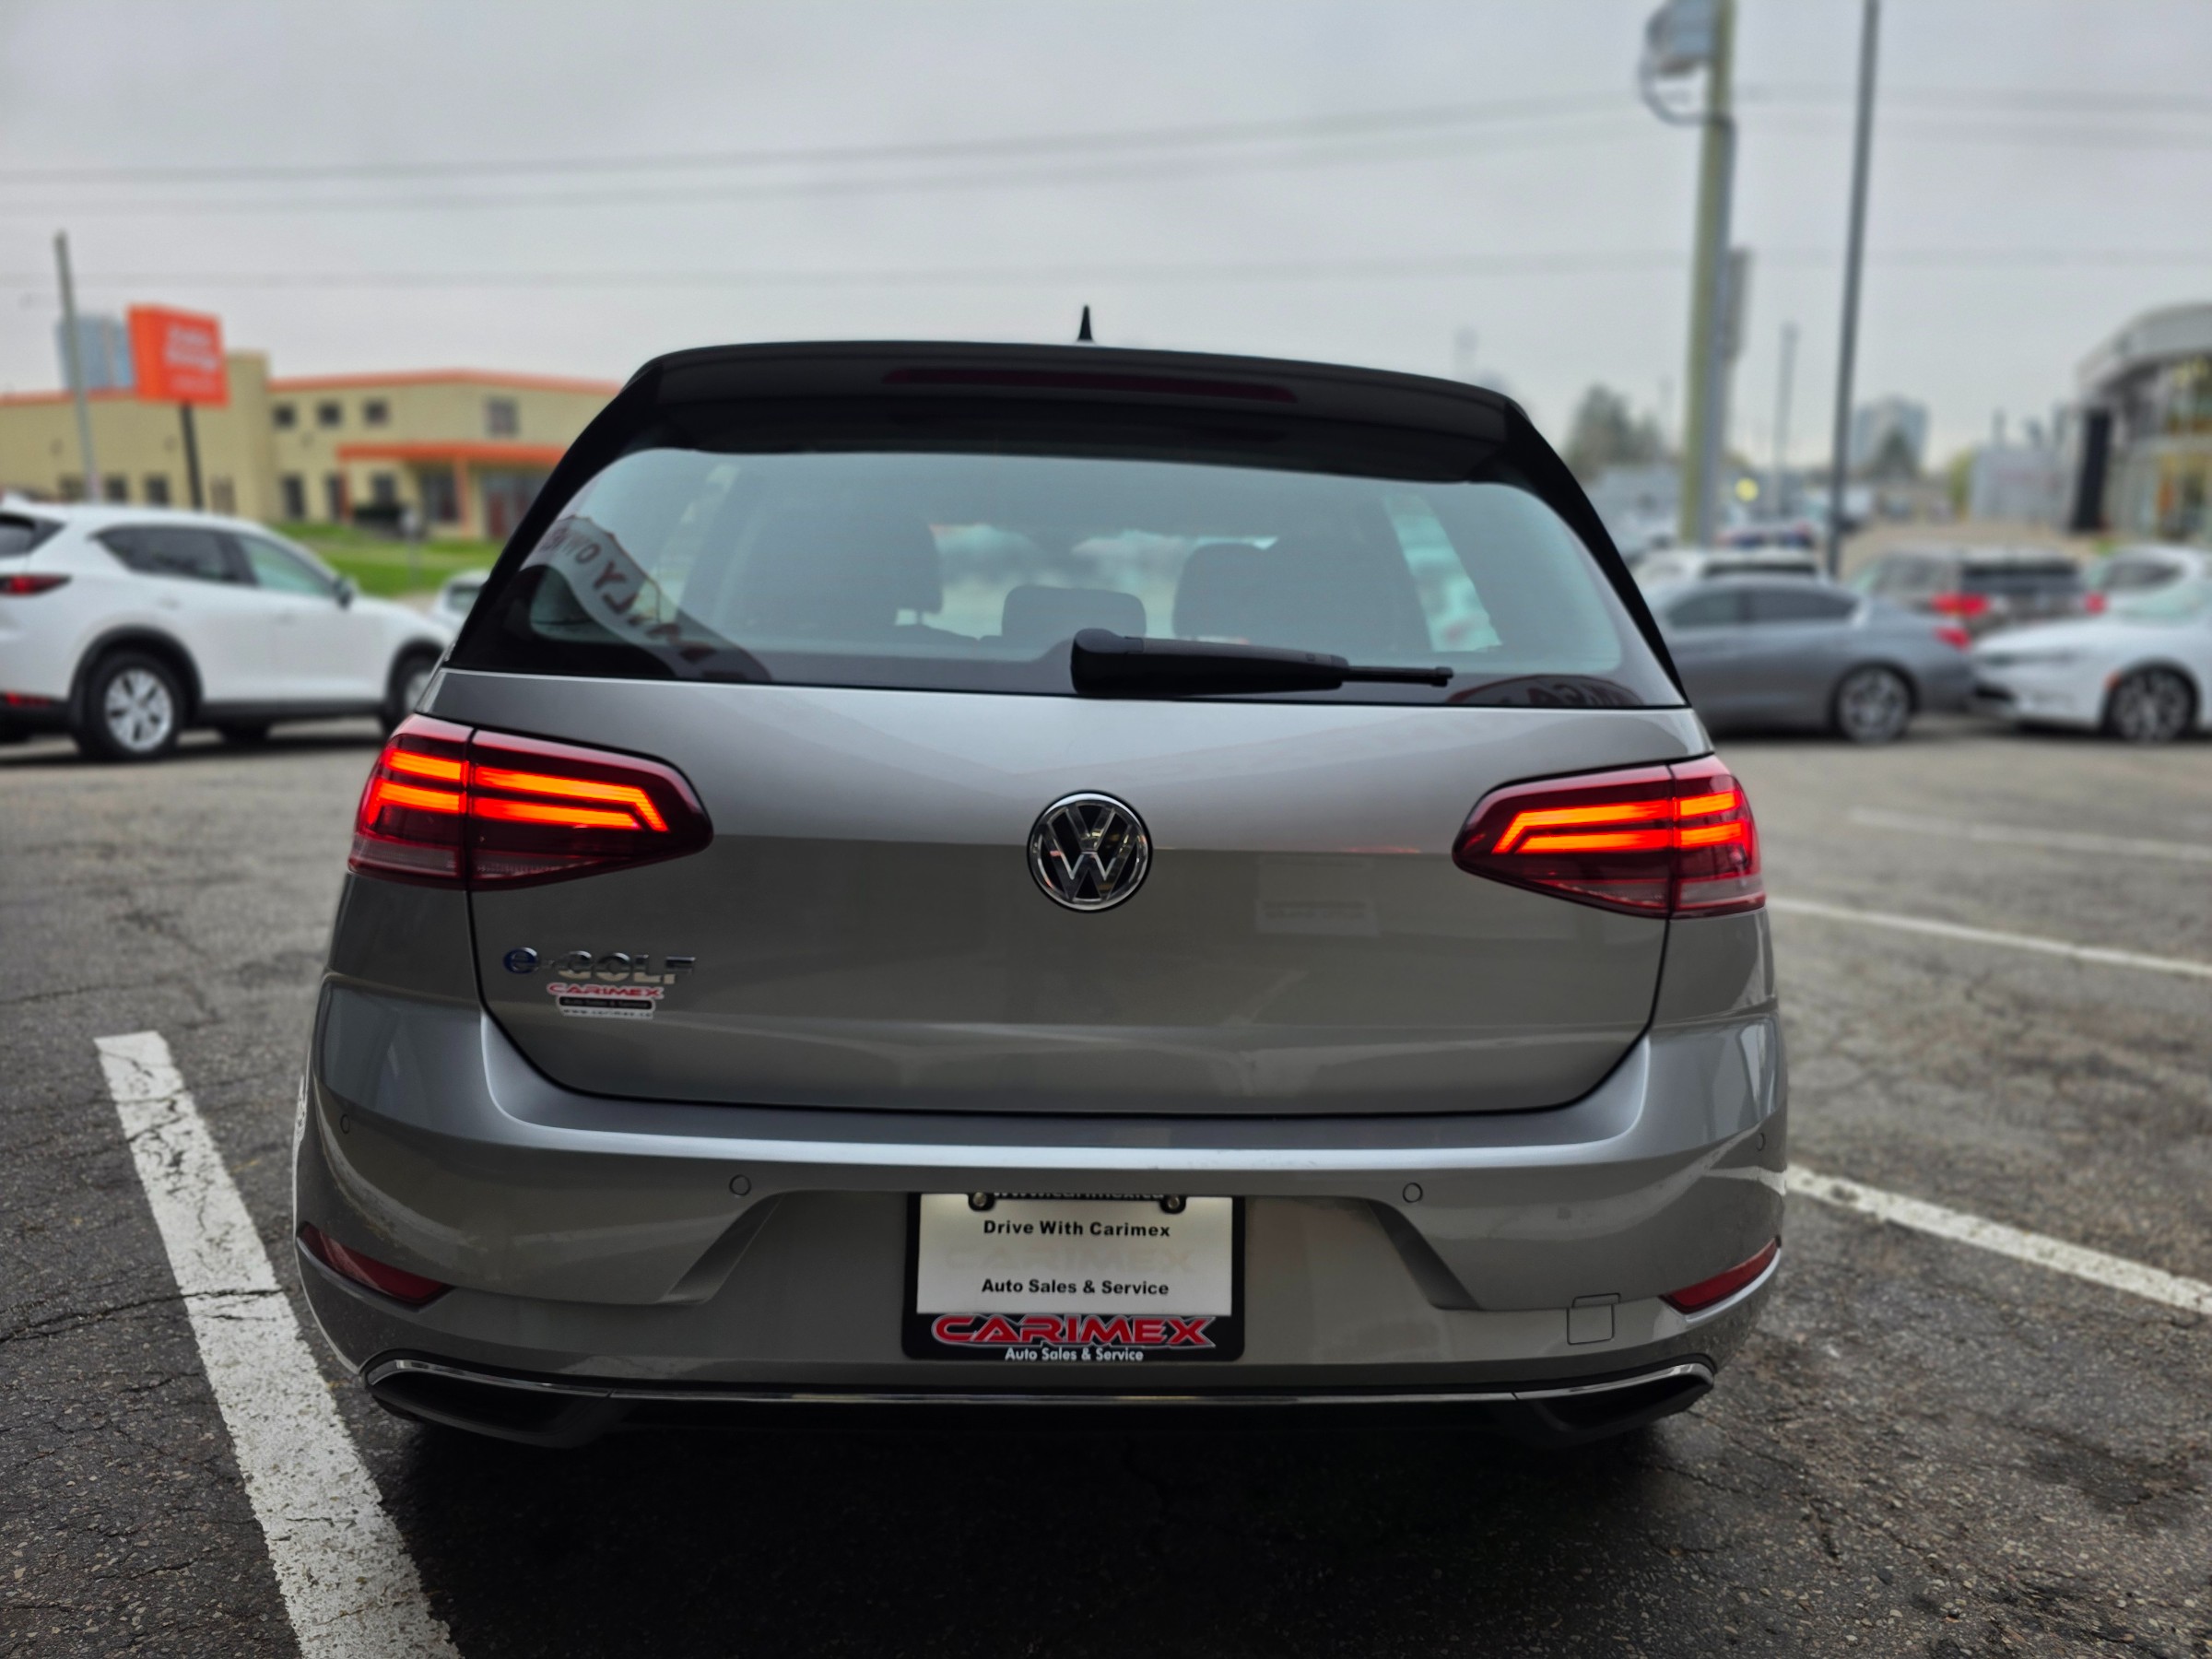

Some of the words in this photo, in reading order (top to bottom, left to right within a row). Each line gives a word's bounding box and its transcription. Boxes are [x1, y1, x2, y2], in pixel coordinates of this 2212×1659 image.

[548, 983, 663, 998] CARIMEX
[982, 1219, 1034, 1234] Drive
[1040, 1220, 1084, 1235] With
[1089, 1221, 1171, 1237] Carimex
[982, 1278, 1024, 1292] Auto
[1029, 1278, 1077, 1293] Sales
[1082, 1279, 1096, 1294] &
[1101, 1280, 1170, 1295] Service
[932, 1314, 1216, 1348] CARIMEX
[1005, 1347, 1038, 1360] Auto
[1041, 1347, 1077, 1360] Sales
[1081, 1347, 1091, 1360] &
[1096, 1347, 1144, 1361] Service
